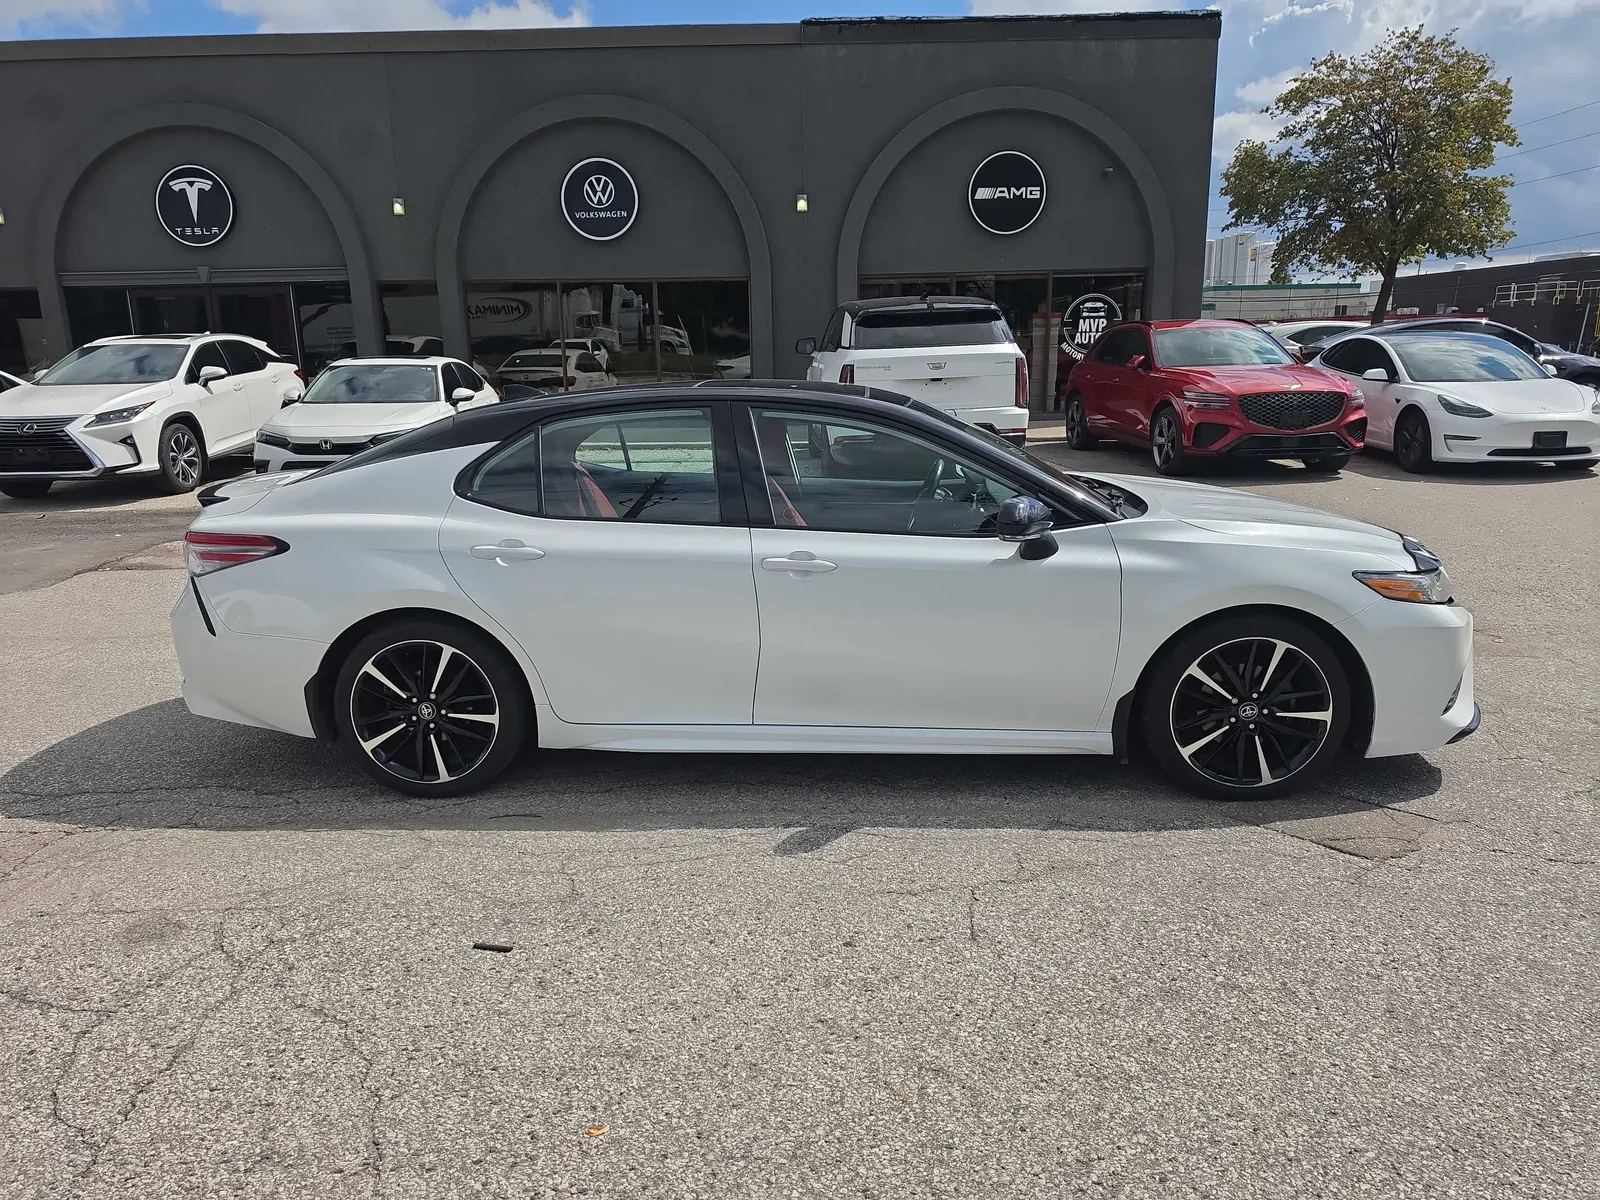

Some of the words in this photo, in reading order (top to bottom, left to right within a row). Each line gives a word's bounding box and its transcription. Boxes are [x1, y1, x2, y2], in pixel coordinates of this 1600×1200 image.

[994, 187, 1040, 199] AMG
[574, 210, 627, 219] VOLKSWAGEN
[175, 227, 220, 235] TESLA
[1078, 318, 1107, 332] MVP
